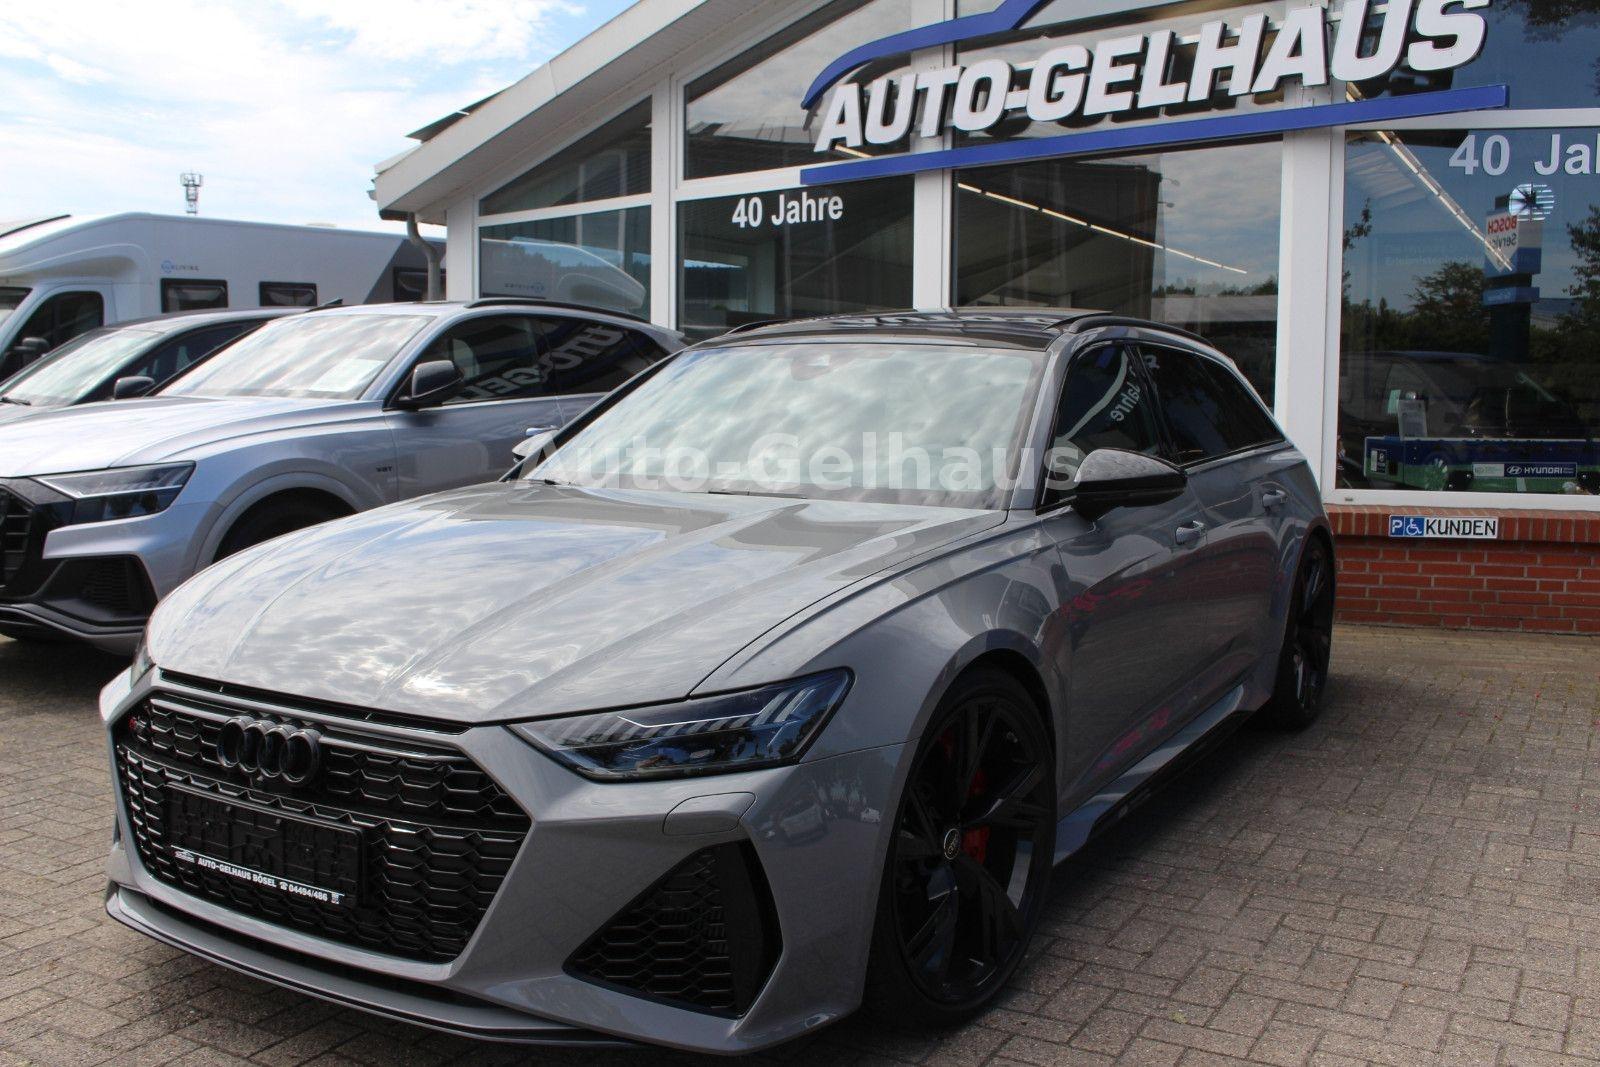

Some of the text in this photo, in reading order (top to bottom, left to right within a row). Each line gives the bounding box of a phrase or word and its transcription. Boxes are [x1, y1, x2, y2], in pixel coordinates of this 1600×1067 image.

[814, 0, 1489, 153] AUTO-GELHAUS
[1448, 133, 1600, 176] 40 Ja
[731, 191, 844, 228] 40 Jahre
[1524, 466, 1563, 474] HYUNDAI
[1426, 519, 1496, 536] KUNDEN
[197, 857, 252, 881] AUTO-GELHAUS
